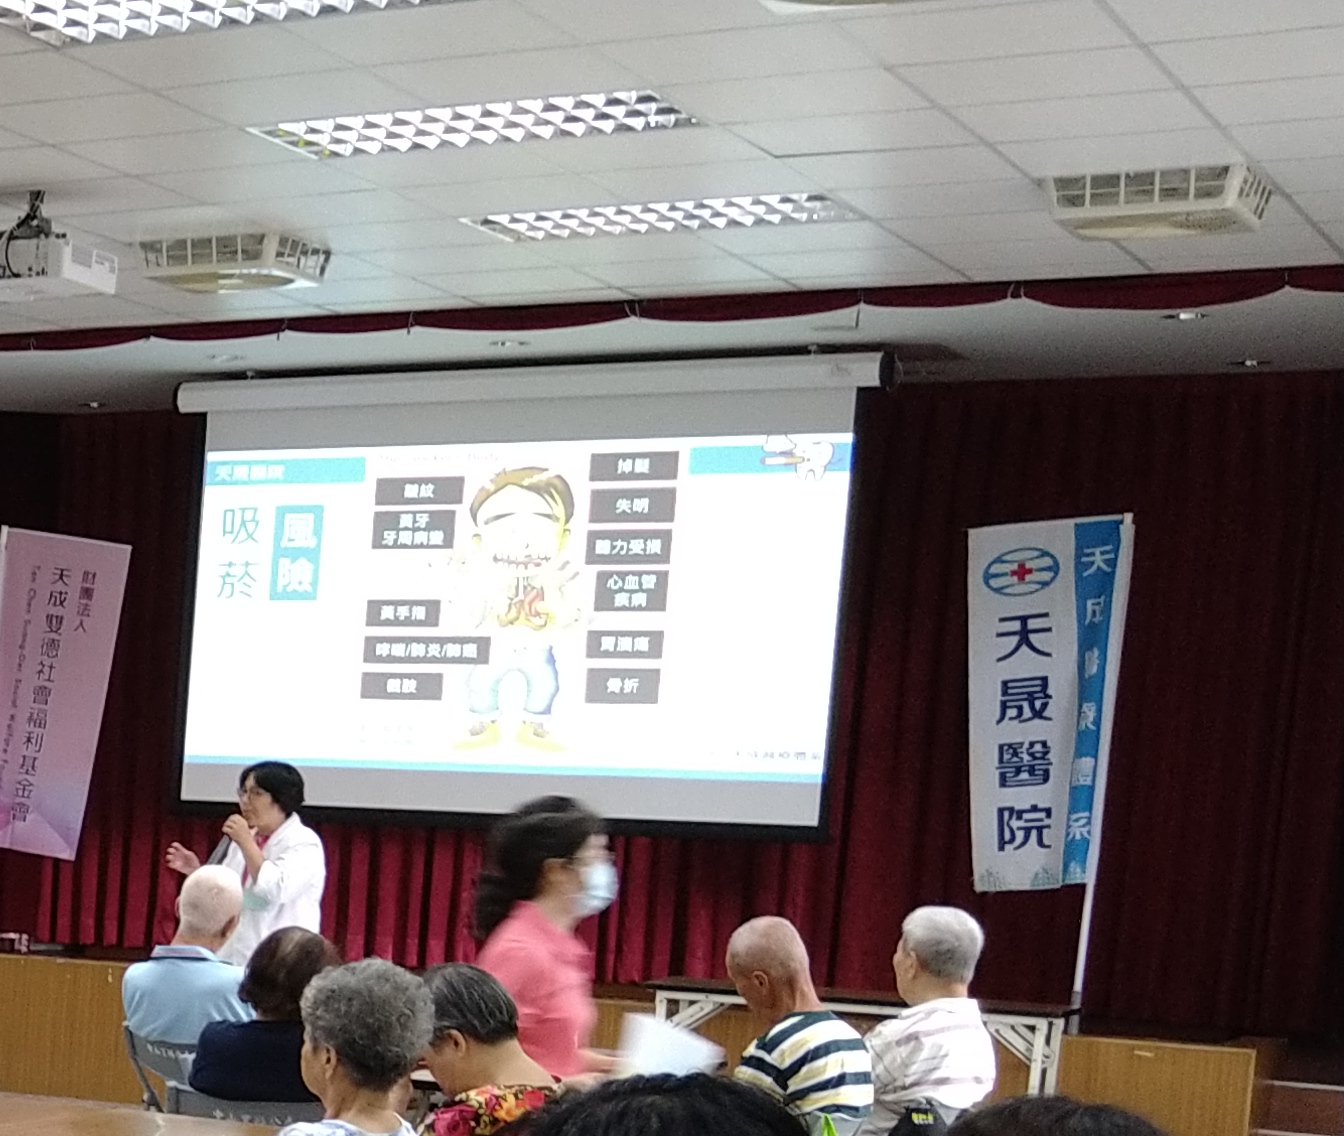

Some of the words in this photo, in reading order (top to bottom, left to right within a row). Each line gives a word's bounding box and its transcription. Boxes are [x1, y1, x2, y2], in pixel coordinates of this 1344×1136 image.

[616, 497, 649, 514] 失明
[217, 507, 260, 599] 吸菸
[275, 512, 317, 594] 風險
[606, 574, 657, 591] 心血管
[73, 569, 97, 633] 財團法人
[11, 566, 72, 823] 天成雙德社會福利基金會
[995, 612, 1054, 853] 天晟醫院
